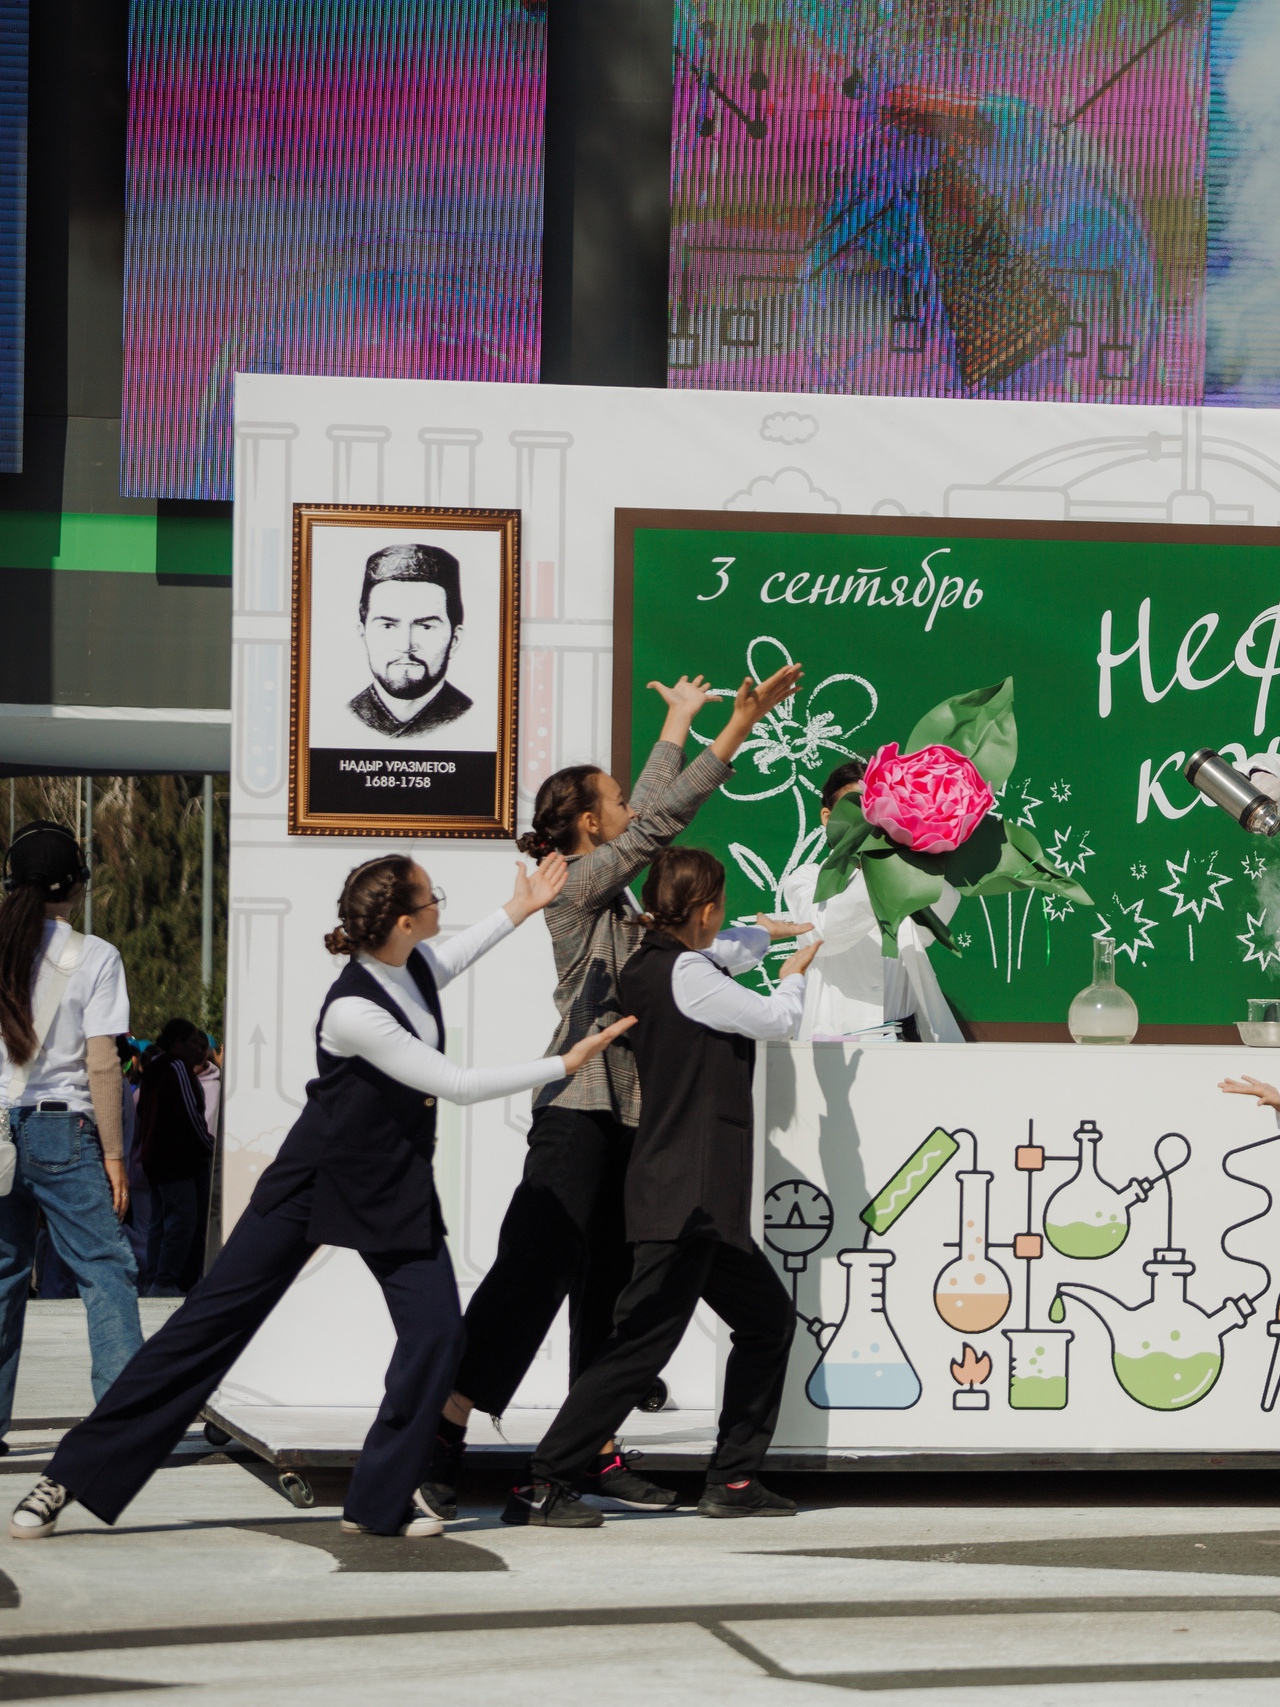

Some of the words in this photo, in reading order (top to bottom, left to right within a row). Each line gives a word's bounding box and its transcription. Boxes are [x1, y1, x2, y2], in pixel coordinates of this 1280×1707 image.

[696, 556, 736, 601] 3
[760, 547, 984, 632] сентябрь
[339, 759, 383, 773] НАДЫР
[385, 760, 457, 773] УРАЗМЕТОВ
[365, 775, 431, 788] 1688-1758
